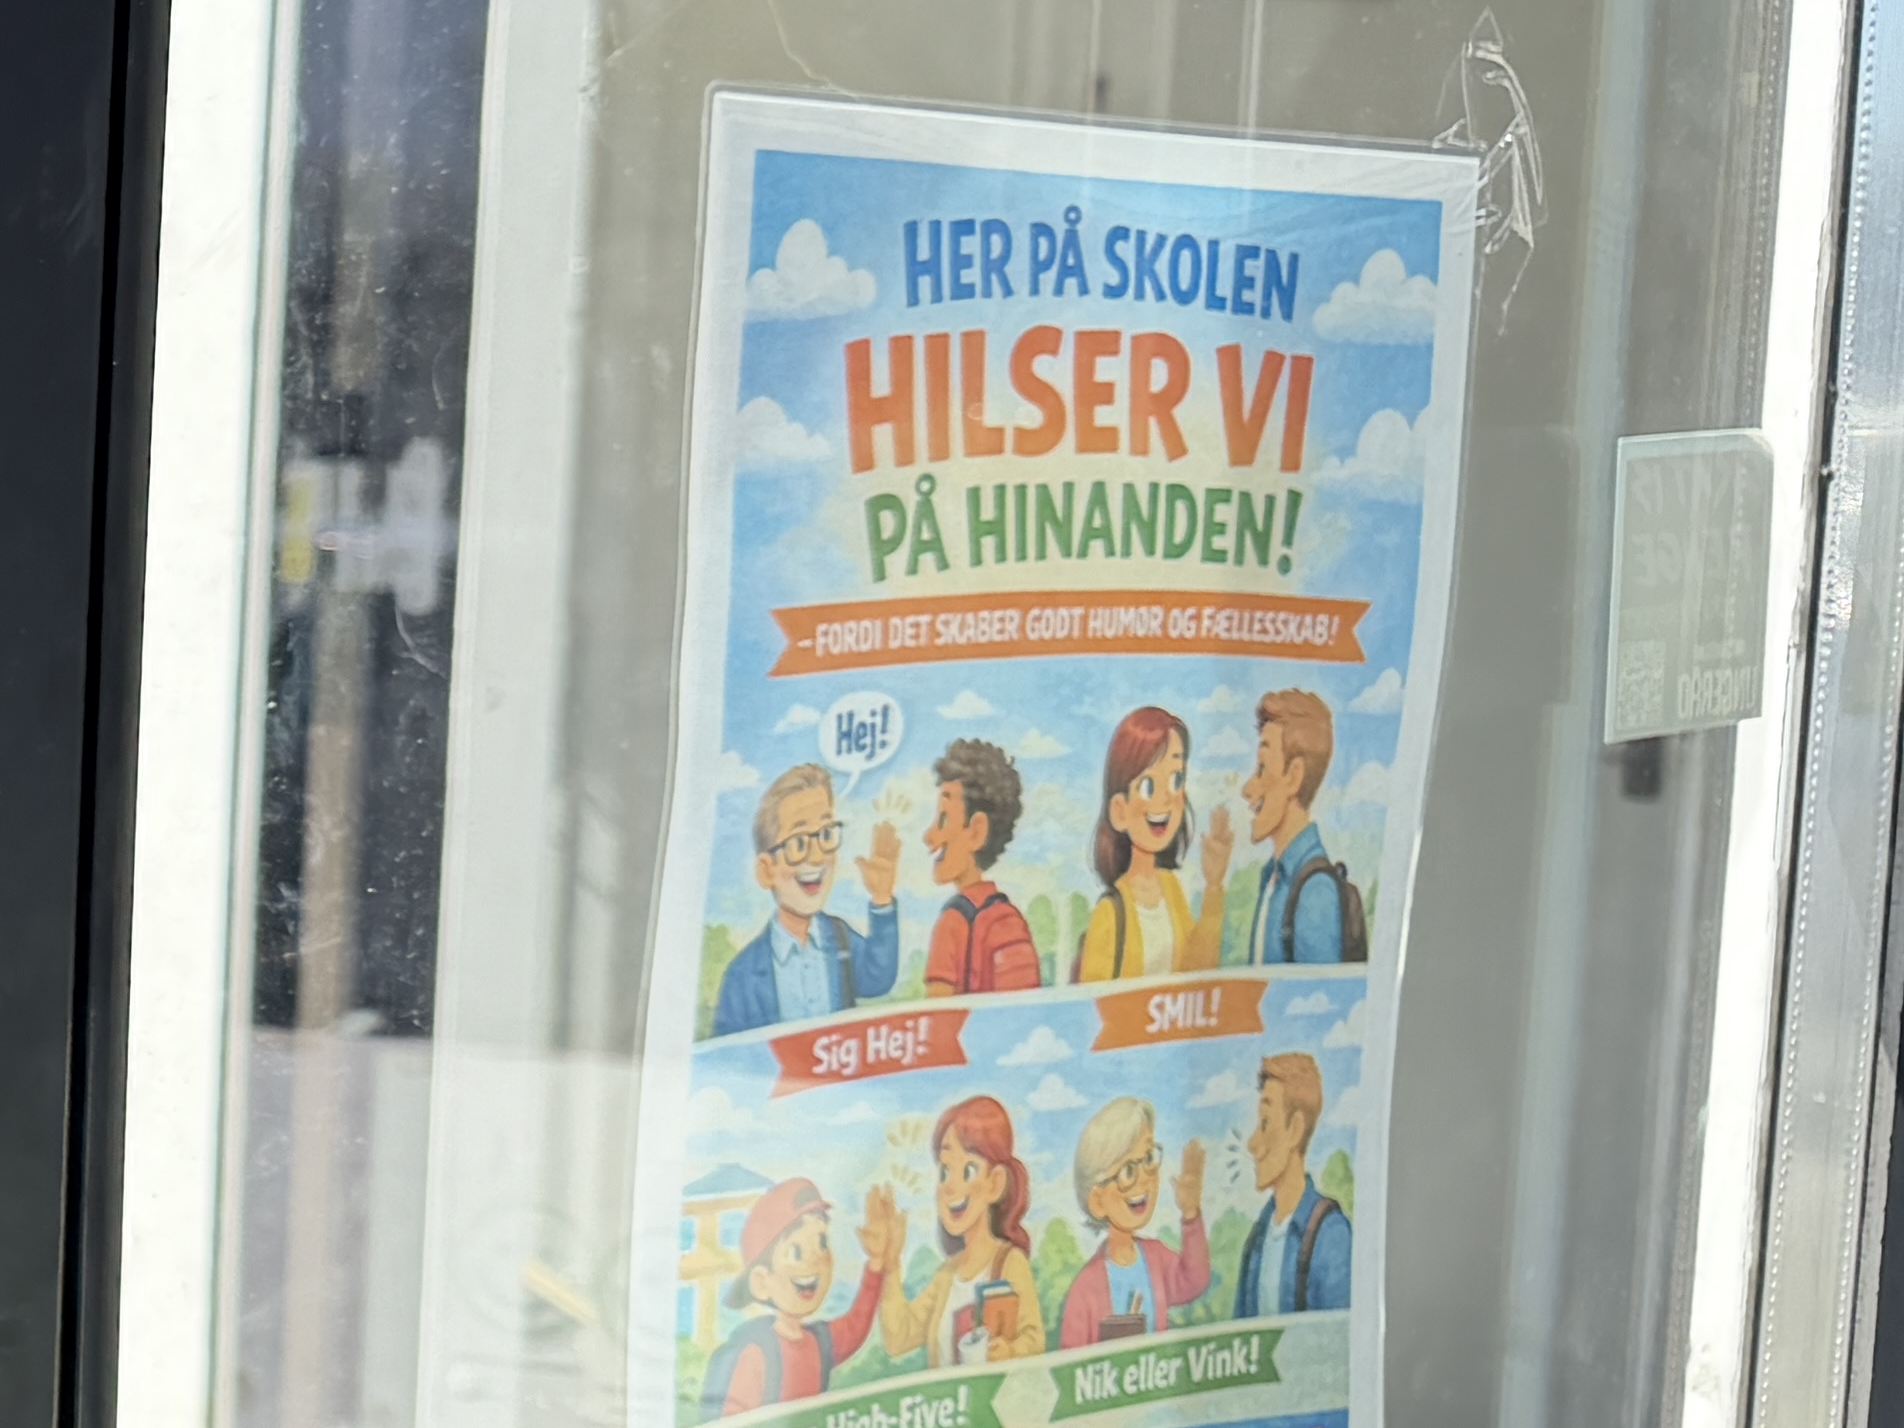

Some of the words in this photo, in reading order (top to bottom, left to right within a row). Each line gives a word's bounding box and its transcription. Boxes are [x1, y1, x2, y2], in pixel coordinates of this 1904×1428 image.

[902, 218, 1015, 308] HER
[1028, 204, 1091, 298] PÅ
[1103, 225, 1300, 323] SKOLEN
[843, 324, 1192, 474] HILSER
[1215, 341, 1315, 474] VI
[863, 473, 951, 584] PÅ
[965, 480, 1304, 577] HINANDEN!
[815, 618, 885, 658] FORDI
[888, 613, 932, 650] DET
[934, 607, 1022, 646] SKABER
[1025, 605, 1085, 641] GODT
[1087, 604, 1165, 640] HUMØR
[1168, 606, 1198, 640] OG
[1200, 605, 1341, 647] FÆLLESSKAB!
[835, 703, 891, 761] Hej!
[1145, 987, 1222, 1034] SMIL!
[812, 1033, 857, 1074] Sig
[866, 1015, 930, 1066] Hej!
[1074, 1359, 1120, 1405] Nik
[1122, 1352, 1184, 1395] eller
[1187, 1334, 1260, 1383] Vink!
